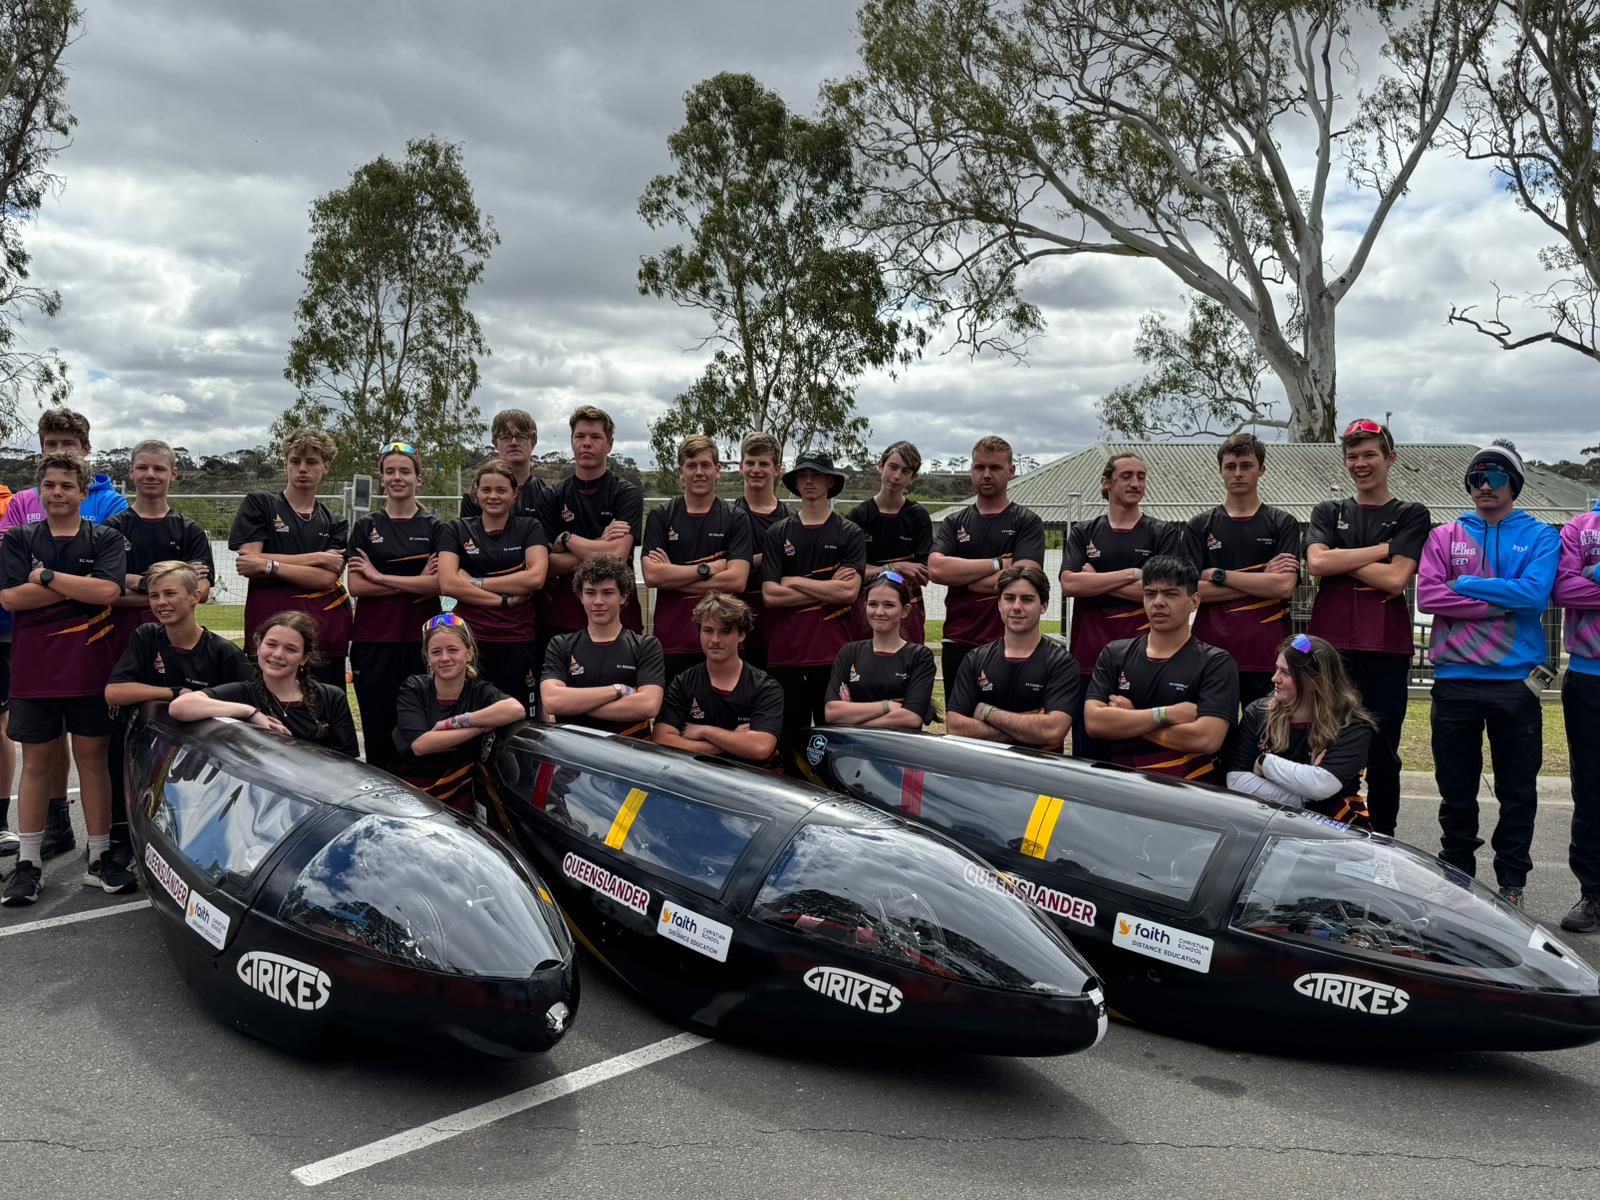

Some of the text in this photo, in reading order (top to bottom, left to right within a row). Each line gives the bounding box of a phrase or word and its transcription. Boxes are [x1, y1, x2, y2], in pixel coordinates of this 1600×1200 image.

[145, 843, 188, 909] QUEENSLANDER
[564, 853, 649, 914] QUEENSLANDER
[964, 863, 1095, 925] QUEENSLANDER
[194, 902, 210, 924] faith
[671, 911, 698, 935] faith
[668, 928, 718, 955] DISTANCE EDUCATION
[701, 932, 720, 945] SCHOOL
[703, 927, 726, 941] CHRISTIAN
[1135, 923, 1171, 945] faith
[1178, 938, 1210, 951] CHRISTIAN
[1131, 939, 1201, 965] DISTANCE EDUCATION
[1177, 943, 1202, 955] SCHOOL
[236, 950, 332, 1010] GTRIKES
[803, 966, 904, 1014] GTRIKES
[1293, 972, 1411, 1015] GTRIKES
